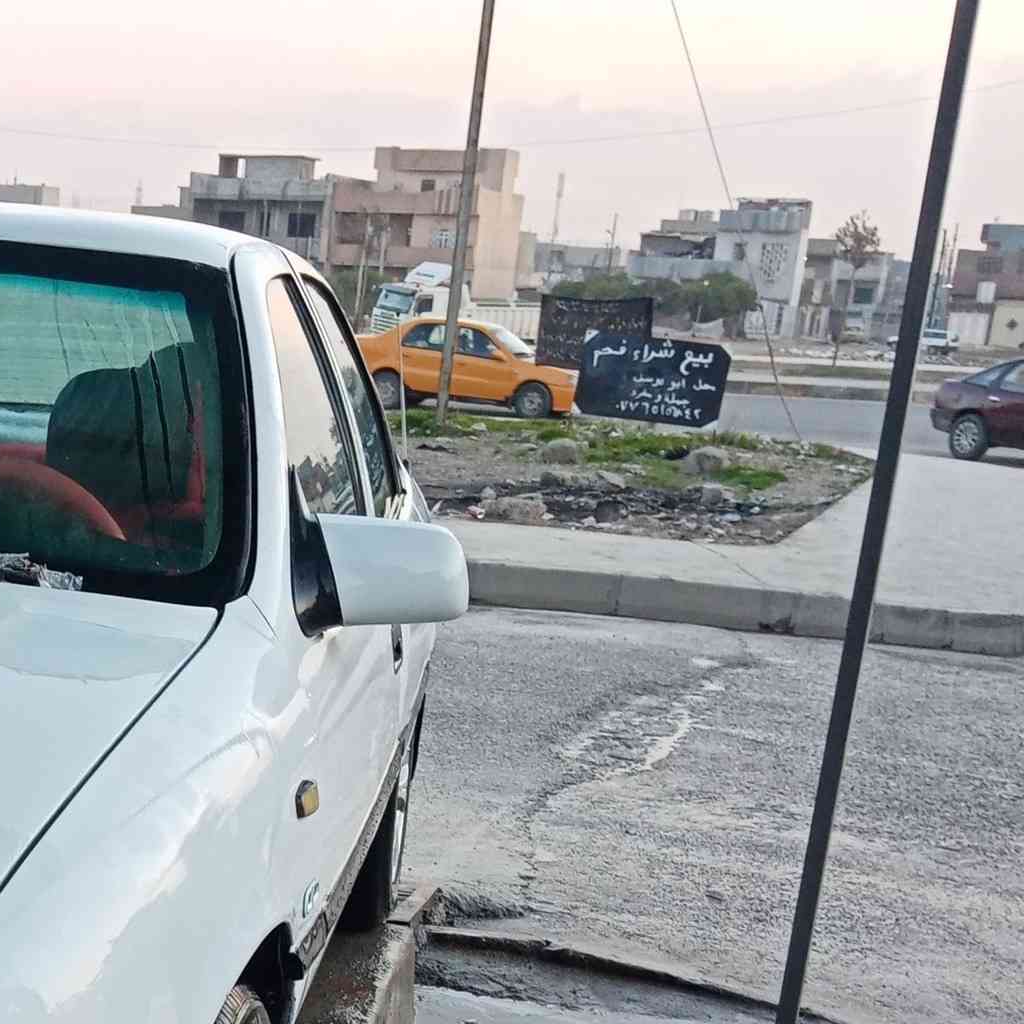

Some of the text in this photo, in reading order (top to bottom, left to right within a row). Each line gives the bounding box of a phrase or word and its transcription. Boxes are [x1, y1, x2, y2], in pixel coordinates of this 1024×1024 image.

[592, 339, 627, 367] فحم
[632, 338, 675, 363] شراء
[680, 350, 714, 375] بيع
